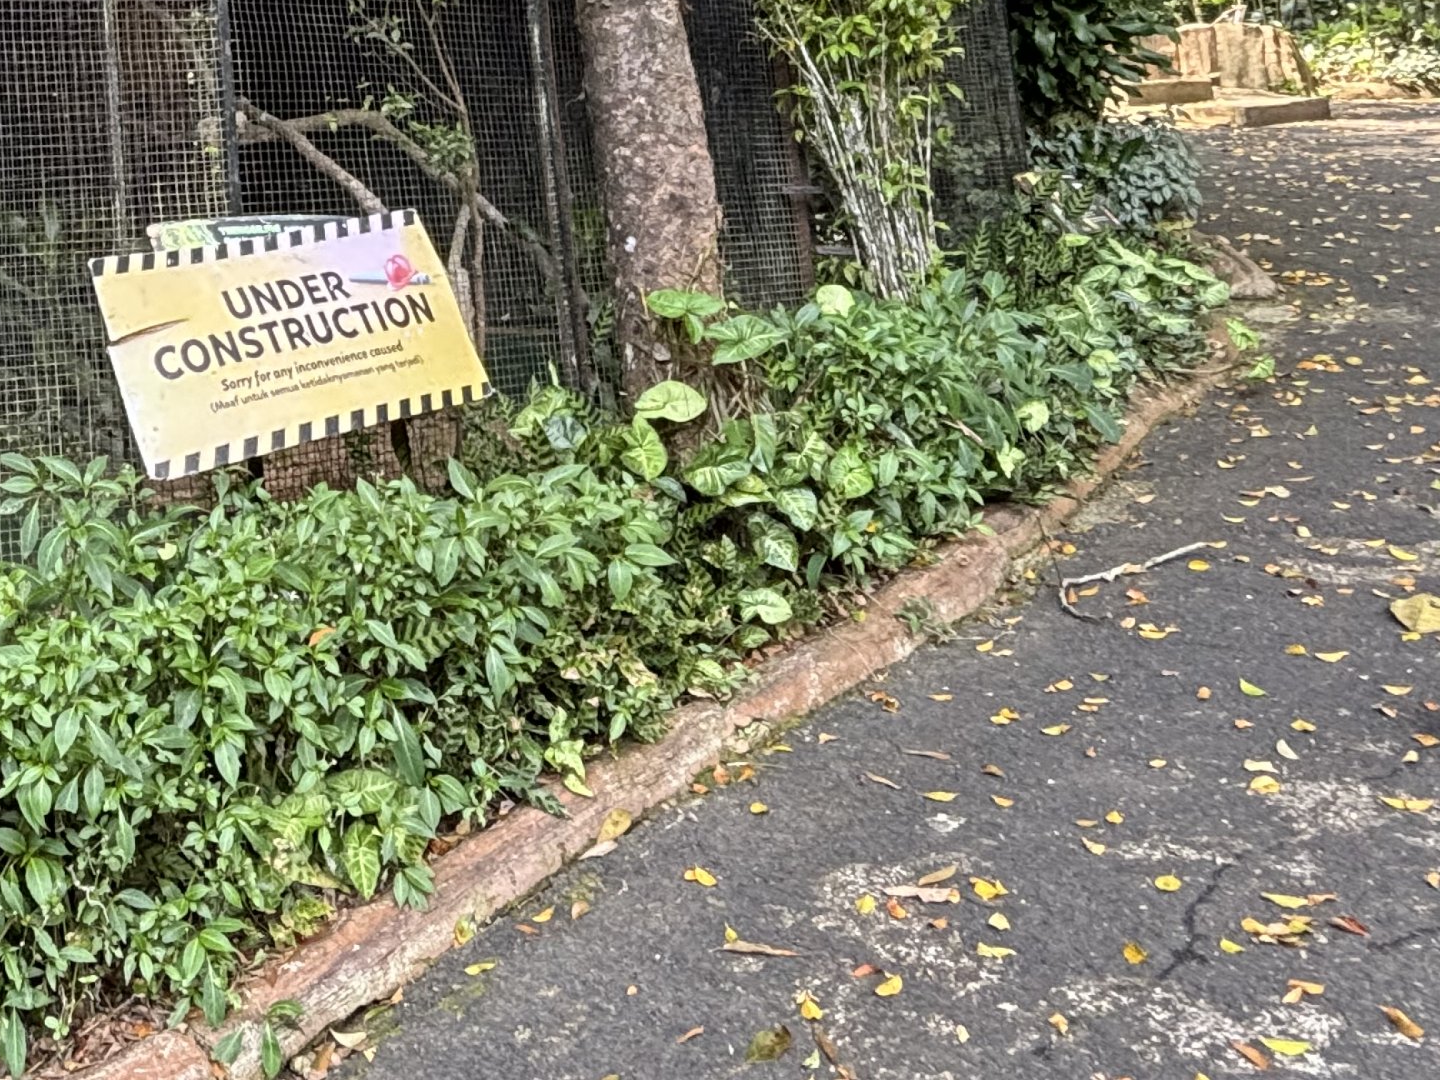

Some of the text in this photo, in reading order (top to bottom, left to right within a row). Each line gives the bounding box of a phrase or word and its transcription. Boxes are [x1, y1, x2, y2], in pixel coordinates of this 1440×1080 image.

[221, 271, 352, 320] UNDER
[154, 292, 436, 380] CONSTRUCTION
[221, 339, 404, 391] Sorry for any inconvenience caused
